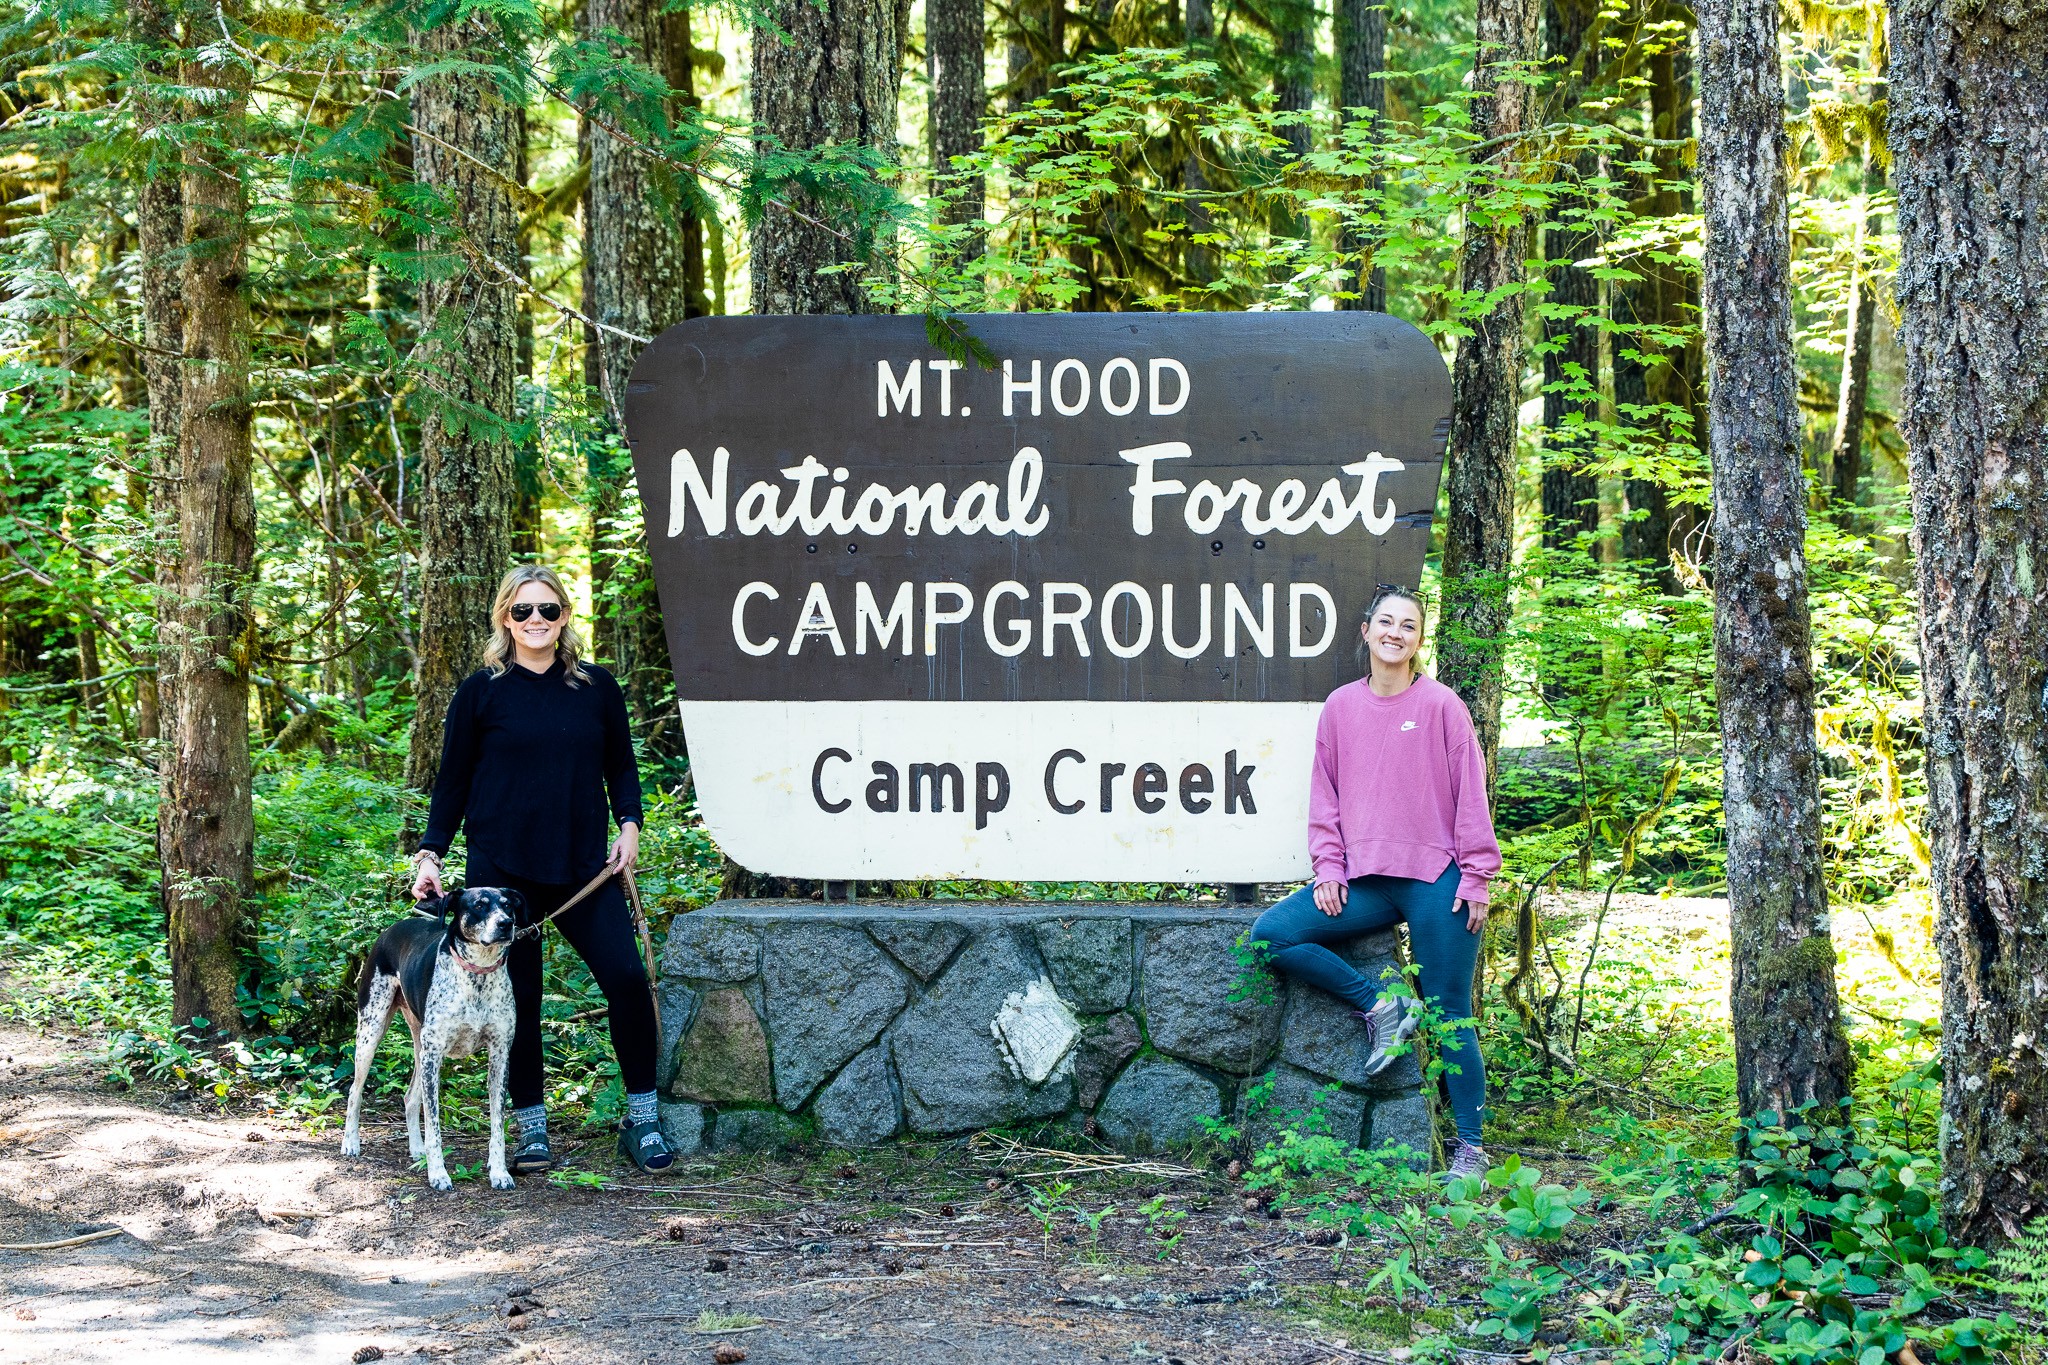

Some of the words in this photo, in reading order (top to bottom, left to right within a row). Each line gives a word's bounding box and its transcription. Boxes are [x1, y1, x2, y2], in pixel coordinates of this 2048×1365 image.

[878, 359, 970, 417] MT.
[1003, 358, 1190, 416] HOOD
[668, 447, 1049, 537] National
[1119, 442, 1405, 536] Forest
[732, 580, 1337, 659] CAMPGROUND
[812, 748, 1010, 830] Camp
[1044, 749, 1257, 814] Creek
